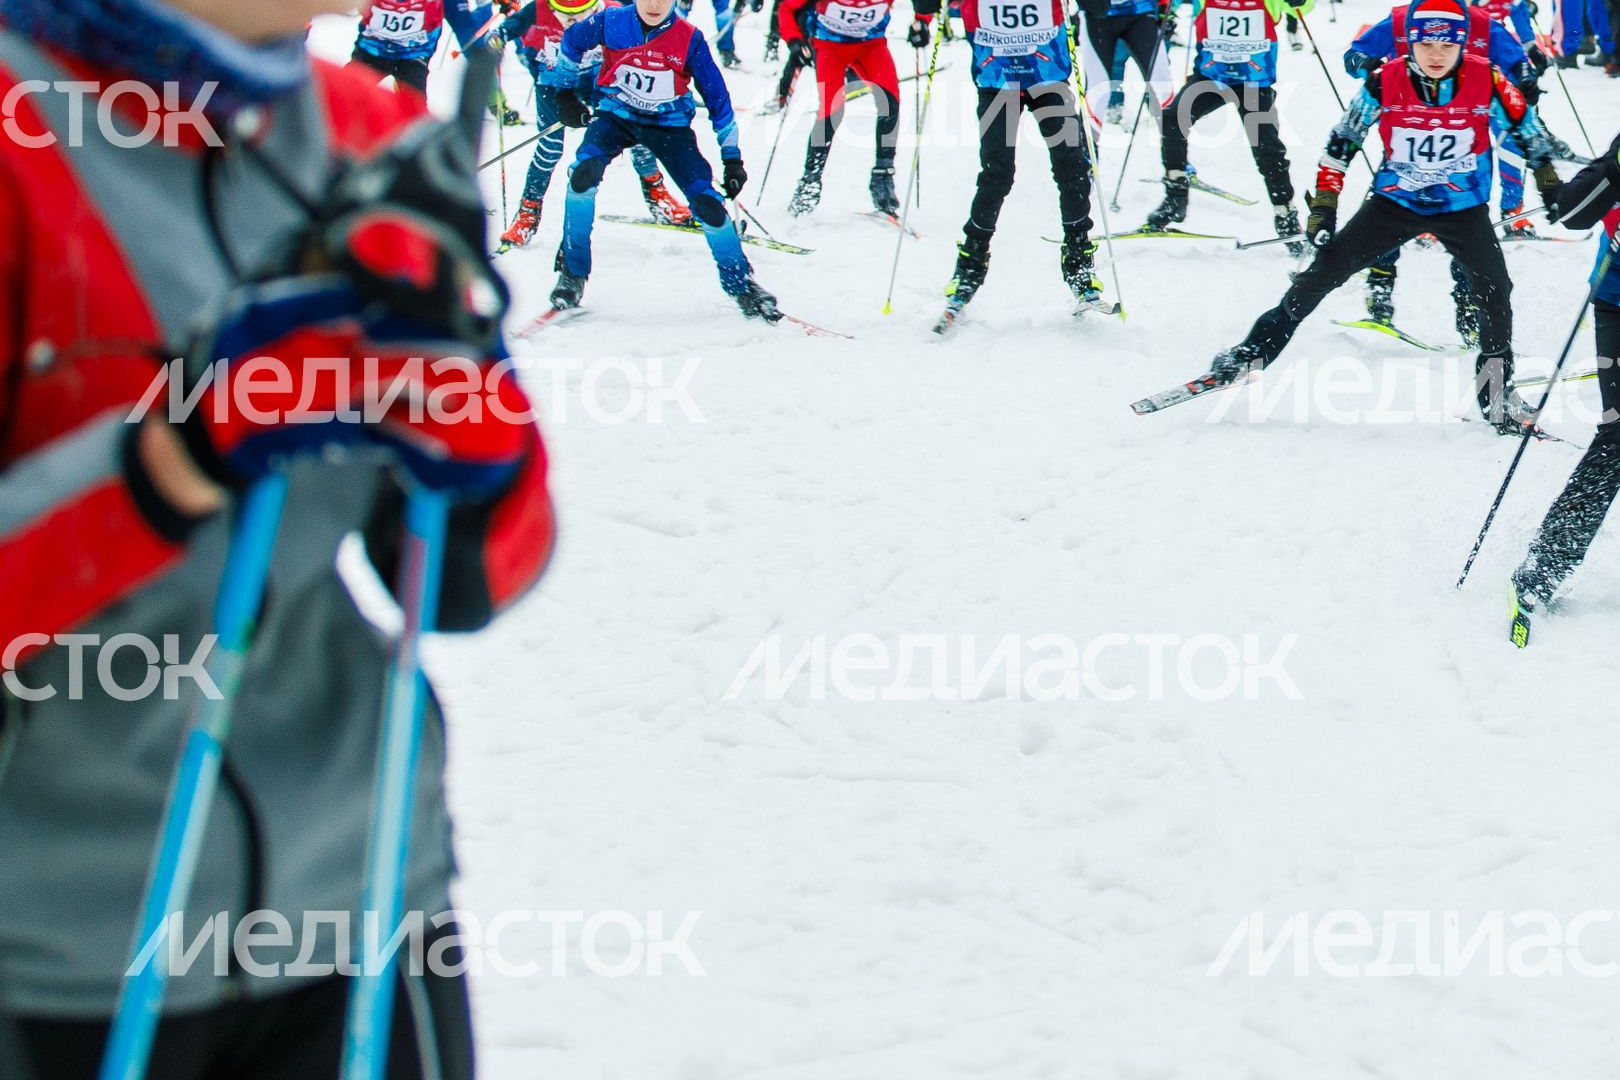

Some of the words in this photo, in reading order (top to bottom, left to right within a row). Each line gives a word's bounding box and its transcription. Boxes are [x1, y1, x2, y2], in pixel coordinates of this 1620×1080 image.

[839, 9, 876, 24] 129
[989, 3, 1039, 29] 156
[1219, 16, 1250, 37] 121
[1405, 134, 1456, 162] 142
